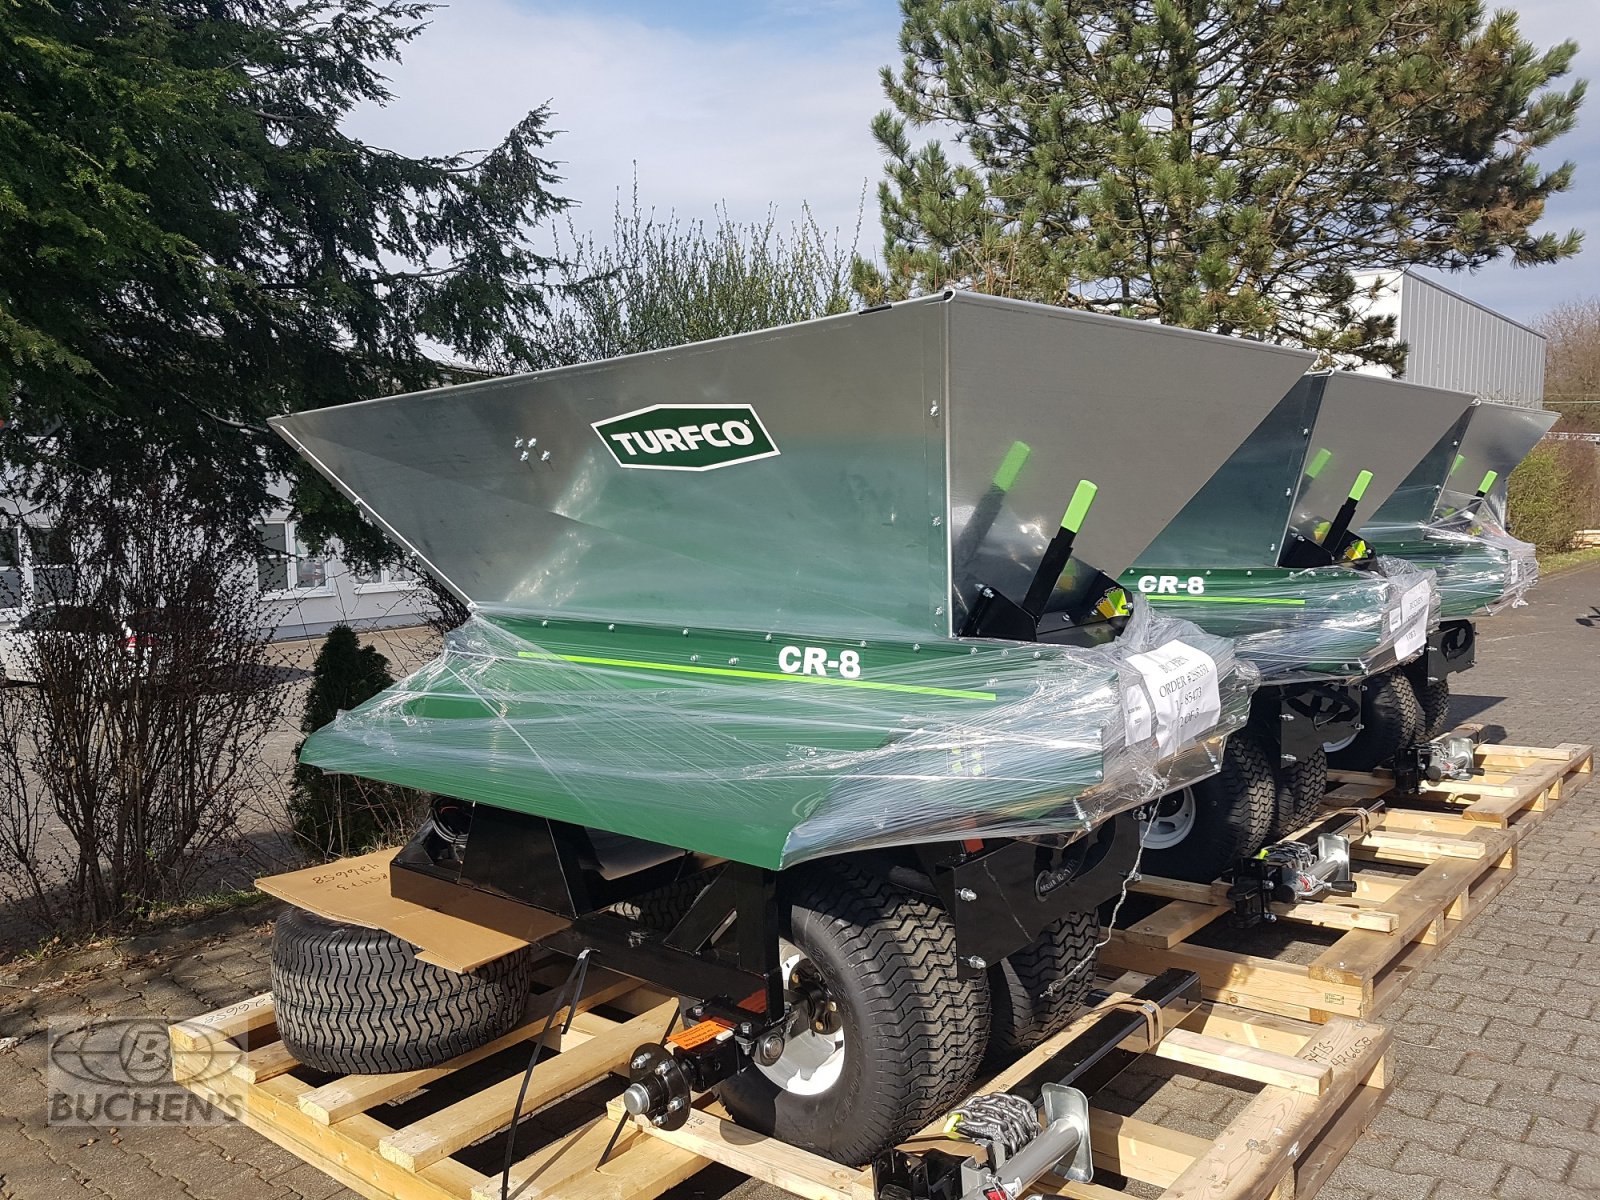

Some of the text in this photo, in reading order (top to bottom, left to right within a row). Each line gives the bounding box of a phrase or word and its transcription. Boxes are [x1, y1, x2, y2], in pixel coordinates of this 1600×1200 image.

[611, 420, 755, 456] TURFCO
[1138, 575, 1205, 595] CR-8
[778, 646, 861, 679] CR-8
[1159, 676, 1187, 698] ORDER
